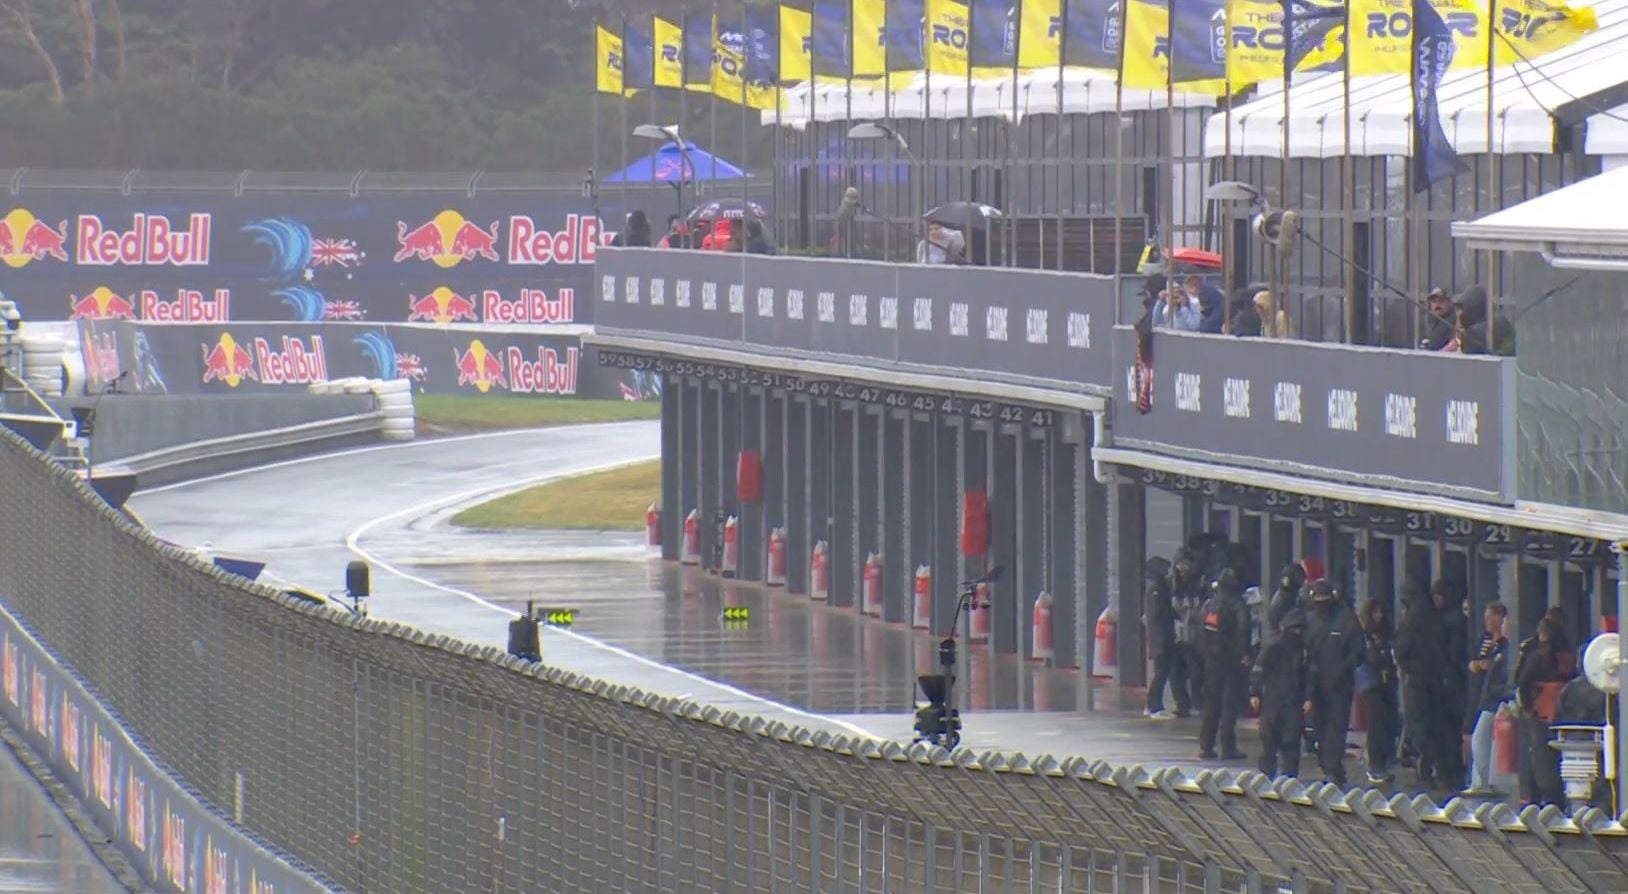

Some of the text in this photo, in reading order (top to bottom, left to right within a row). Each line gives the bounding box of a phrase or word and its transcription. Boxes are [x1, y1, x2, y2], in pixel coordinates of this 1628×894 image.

[1367, 12, 1479, 38] ROR
[740, 371, 758, 384] 5
[860, 388, 880, 402] 47
[886, 393, 907, 406] 46
[913, 397, 935, 410] 45
[942, 399, 962, 413] 4
[1000, 407, 1023, 421] 42
[1032, 411, 1053, 426] 41
[1407, 513, 1434, 531] 31
[1445, 519, 1473, 535] 30
[1485, 525, 1511, 542] 29
[1570, 538, 1599, 556] 27
